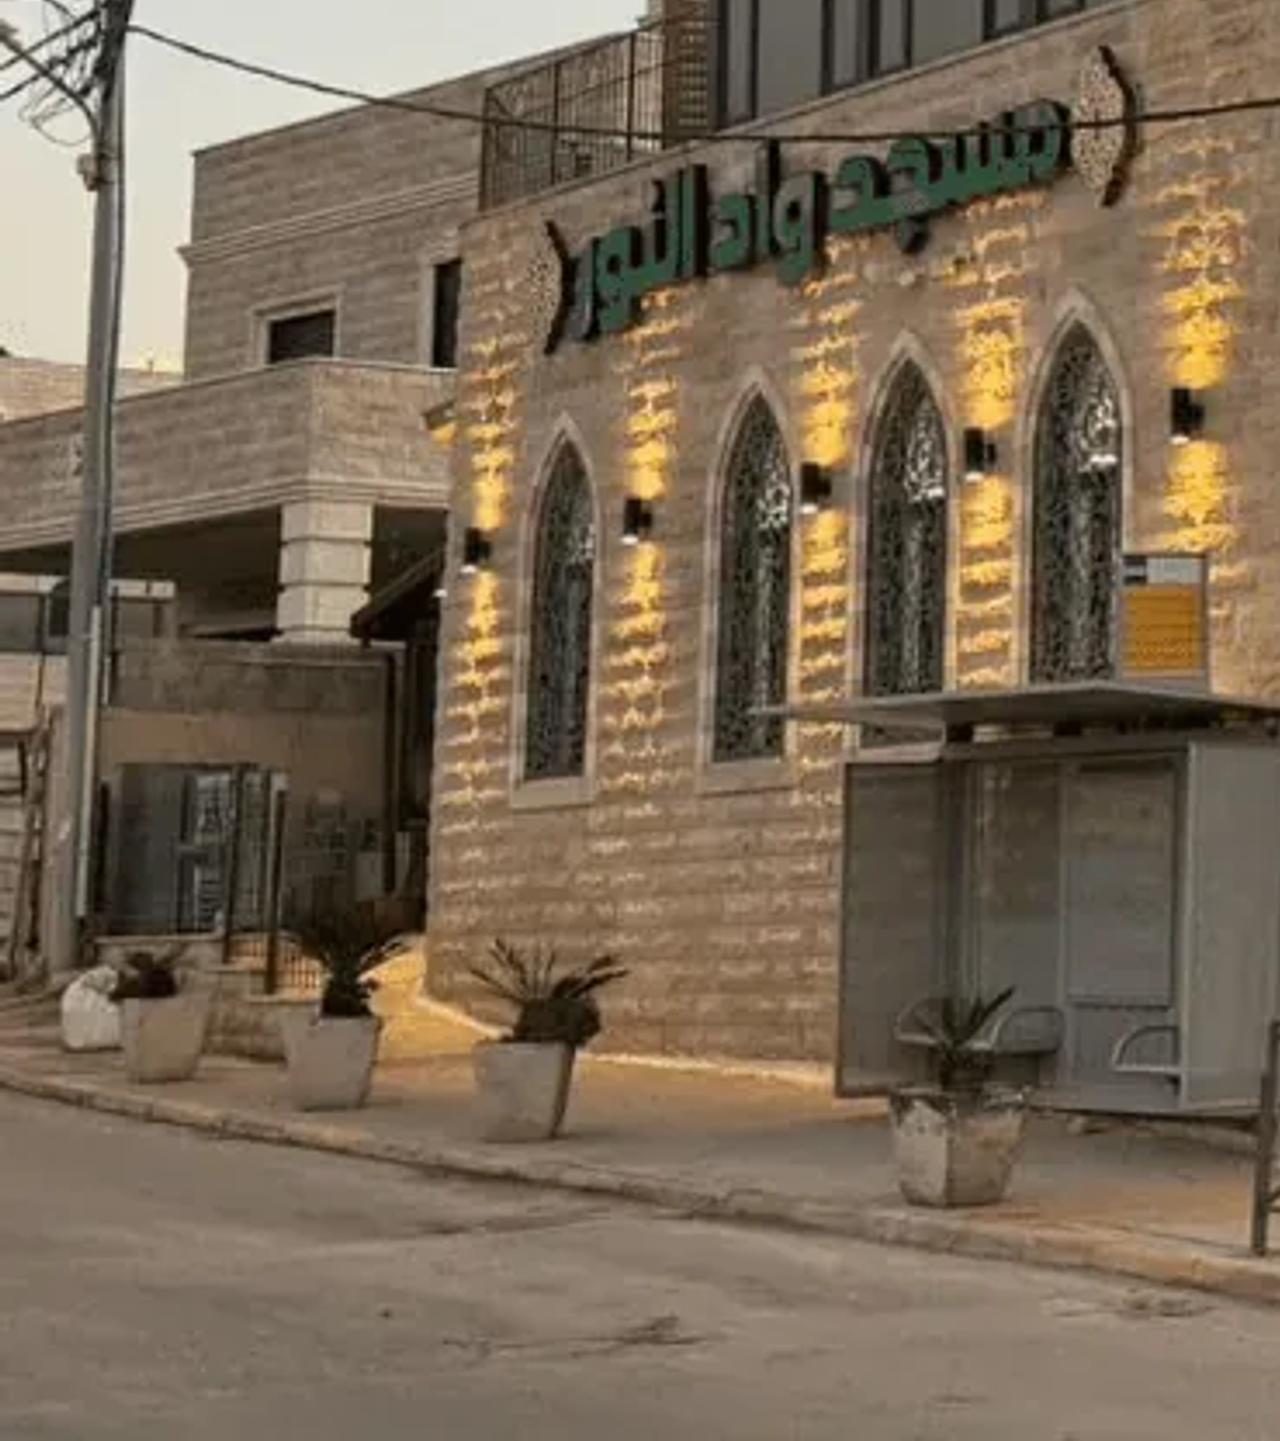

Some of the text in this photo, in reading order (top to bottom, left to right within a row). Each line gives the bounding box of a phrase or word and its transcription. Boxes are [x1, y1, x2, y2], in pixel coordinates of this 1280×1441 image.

[572, 97, 1072, 341] مسجد واد النور
